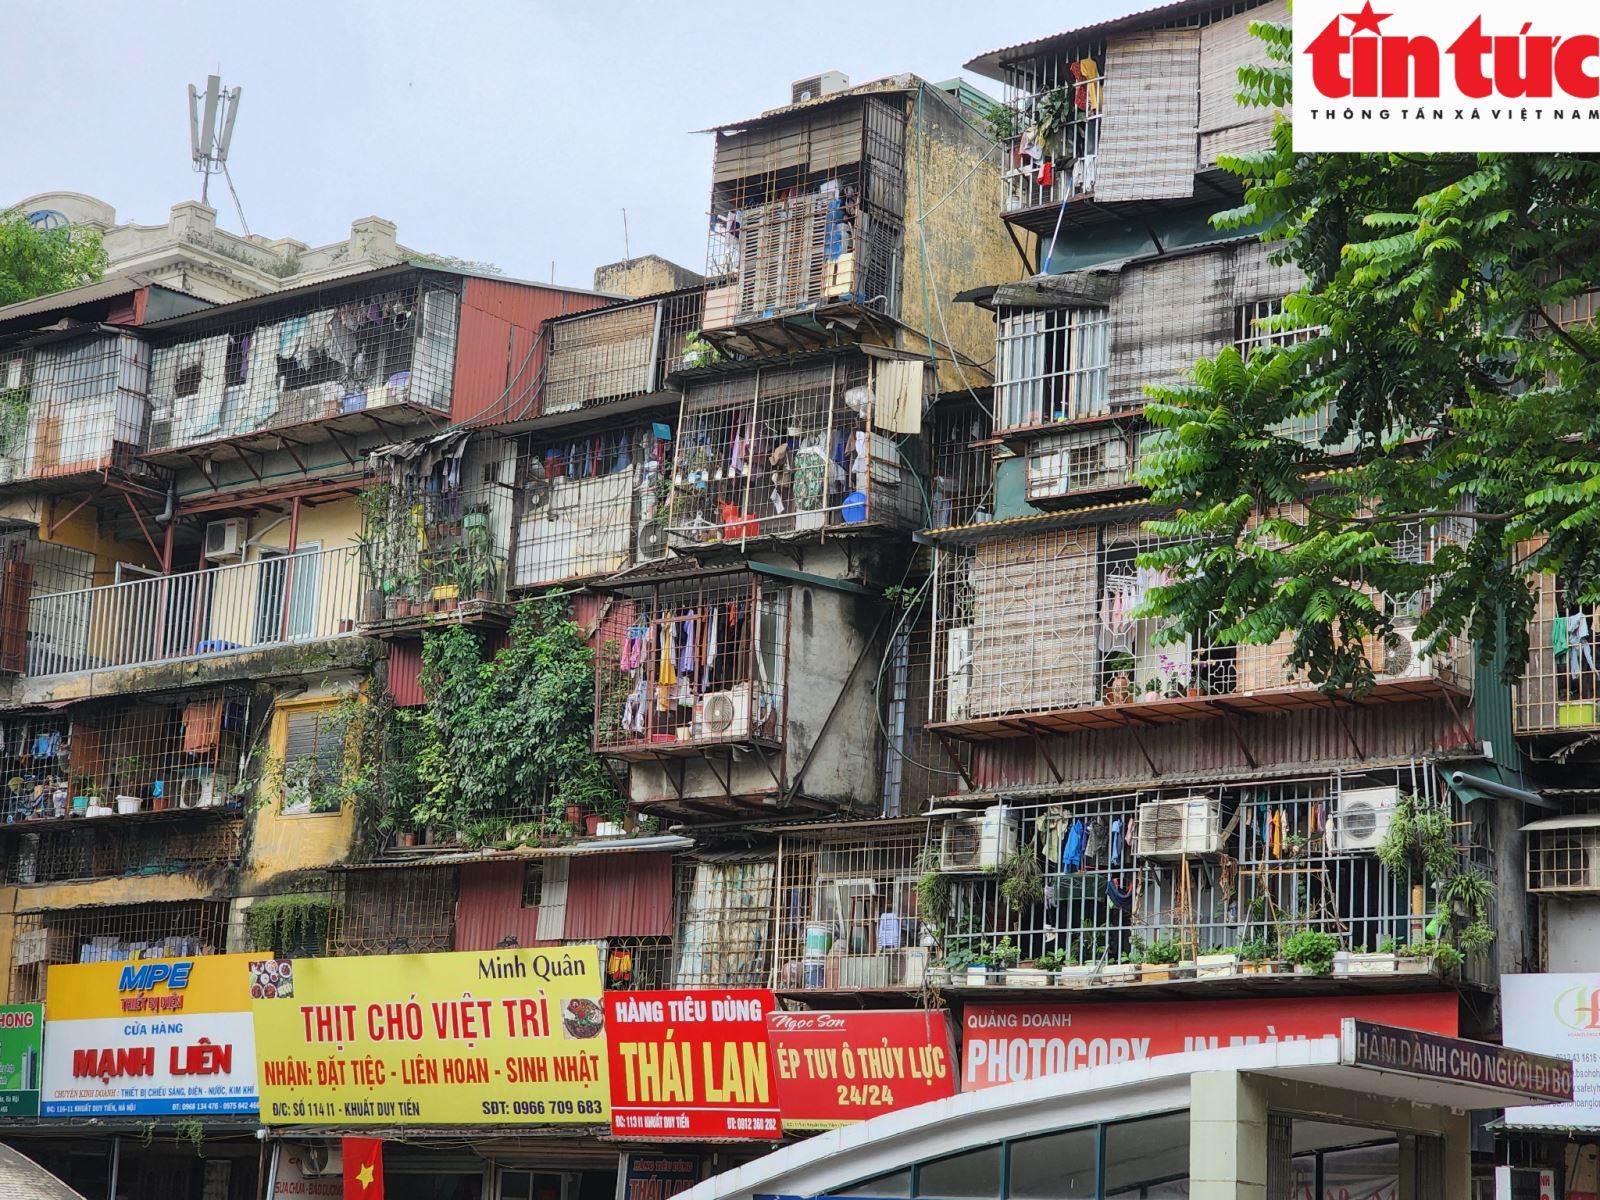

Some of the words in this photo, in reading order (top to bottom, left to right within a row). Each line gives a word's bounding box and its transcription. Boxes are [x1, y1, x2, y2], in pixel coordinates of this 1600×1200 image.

[118, 962, 194, 992] MPE
[478, 956, 526, 980] Minh
[533, 954, 586, 982] Quân
[300, 1005, 357, 1051] THỊT
[367, 993, 424, 1042] CHÓ
[432, 992, 493, 1048] VIỆT
[502, 989, 550, 1038] TRÌ
[615, 999, 664, 1023] HÀNG
[667, 995, 706, 1022] TIÊU
[712, 994, 762, 1022] DÙNG
[968, 1010, 1018, 1028] QUẢNG
[1022, 1013, 1072, 1027] DOANH
[124, 1020, 147, 1036] CỬA
[151, 1020, 183, 1034] HÀNG
[72, 1047, 155, 1085] MẠNH
[169, 1037, 233, 1076] LIÊN
[264, 1055, 313, 1092] NHẬN:
[317, 1055, 346, 1092] ĐẶT
[351, 1054, 386, 1091] TIỆC
[401, 1053, 442, 1085] LIÊN
[443, 1057, 489, 1084] HOAN
[507, 1055, 549, 1083] SINH
[553, 1050, 600, 1088] NHẬT
[619, 1028, 694, 1103] THÁI
[702, 1041, 770, 1104] LAN
[779, 1042, 800, 1079] ÉP
[803, 1048, 838, 1079] TUY
[841, 1042, 852, 1079] Ô
[857, 1037, 904, 1079] THỦY
[911, 1043, 946, 1086] LỰC
[1401, 1033, 1446, 1073] DÀNH
[1450, 1048, 1481, 1079] CHO
[1485, 1053, 1532, 1089] NGƯỜI
[293, 1097, 306, 1116] SỐ
[344, 1097, 375, 1116] KHUẤT
[378, 1101, 395, 1116] DUY
[398, 1096, 420, 1116] TIẾN
[513, 1101, 545, 1115] 0966
[548, 1100, 573, 1115] 709
[577, 1100, 602, 1114] 683
[837, 1084, 894, 1106] 24/24
